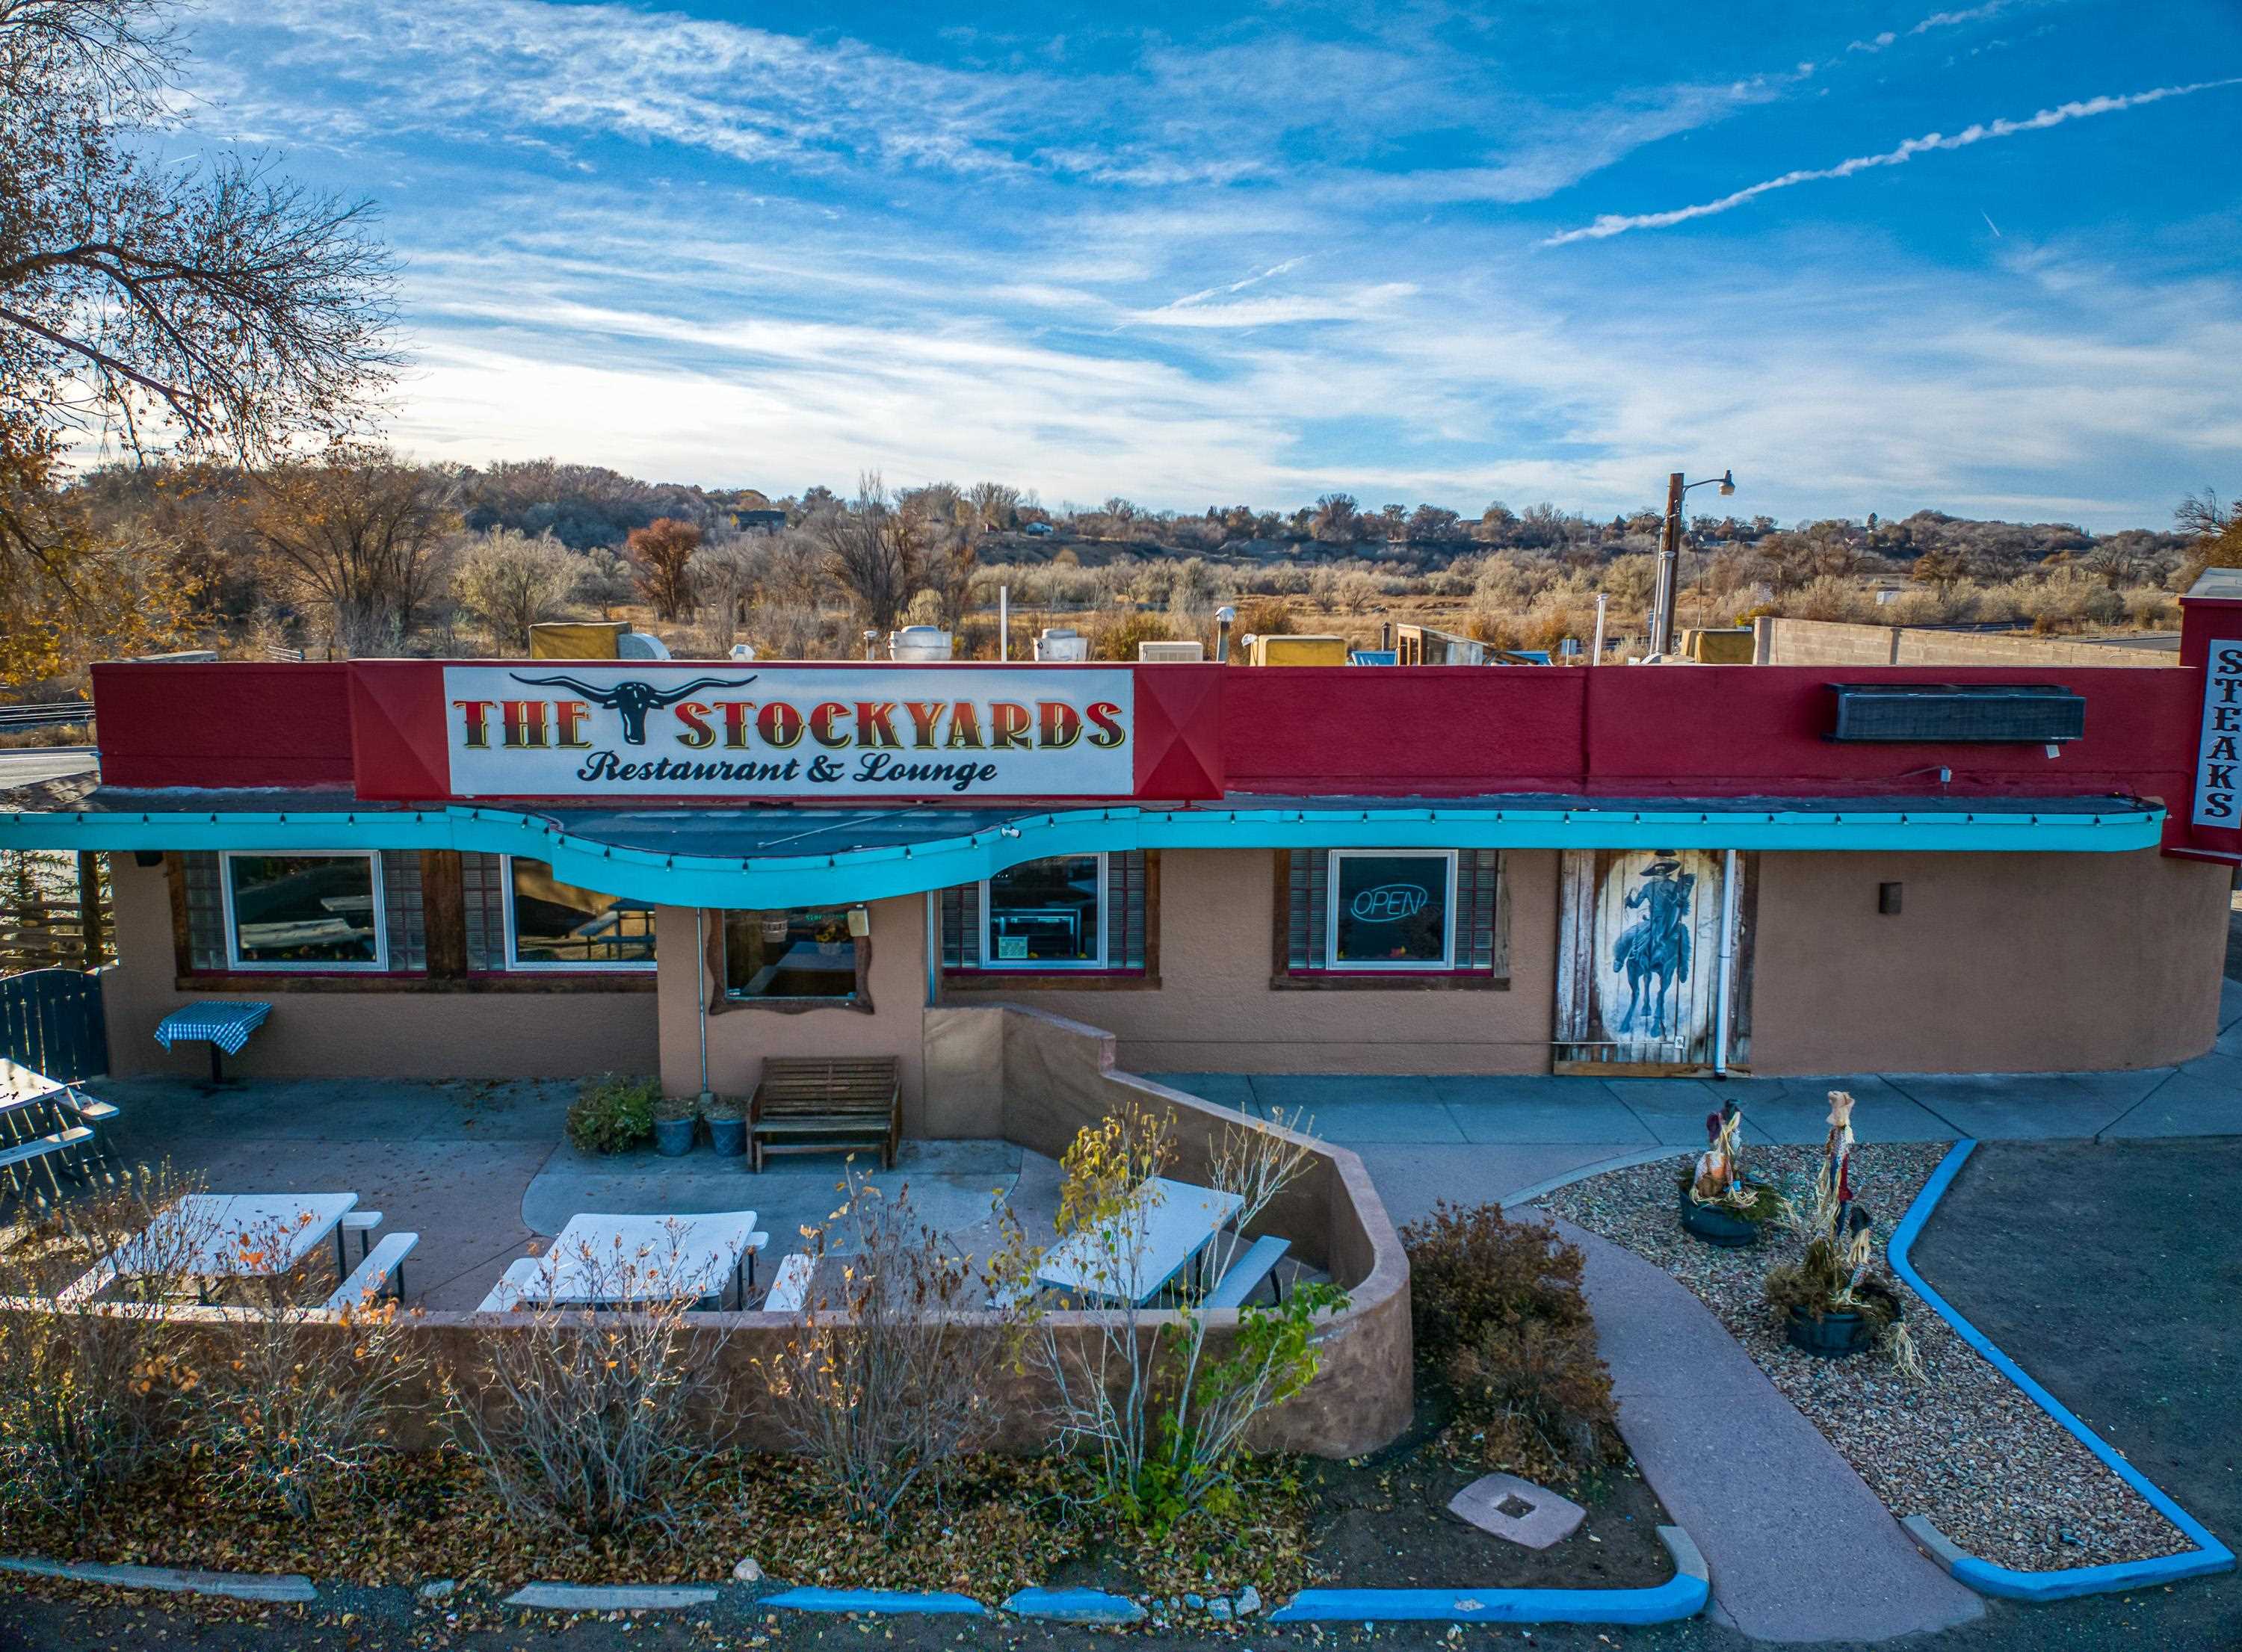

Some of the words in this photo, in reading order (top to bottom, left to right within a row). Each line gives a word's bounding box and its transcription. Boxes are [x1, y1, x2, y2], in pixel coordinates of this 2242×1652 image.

[453, 700, 593, 749] THE
[675, 701, 1125, 750] STOCKYARDS
[2205, 649, 2242, 818] STEAKS
[577, 750, 800, 782] Restaurant
[807, 754, 845, 783] &
[852, 752, 998, 791] Lounge
[1353, 891, 1422, 915] OPEN
